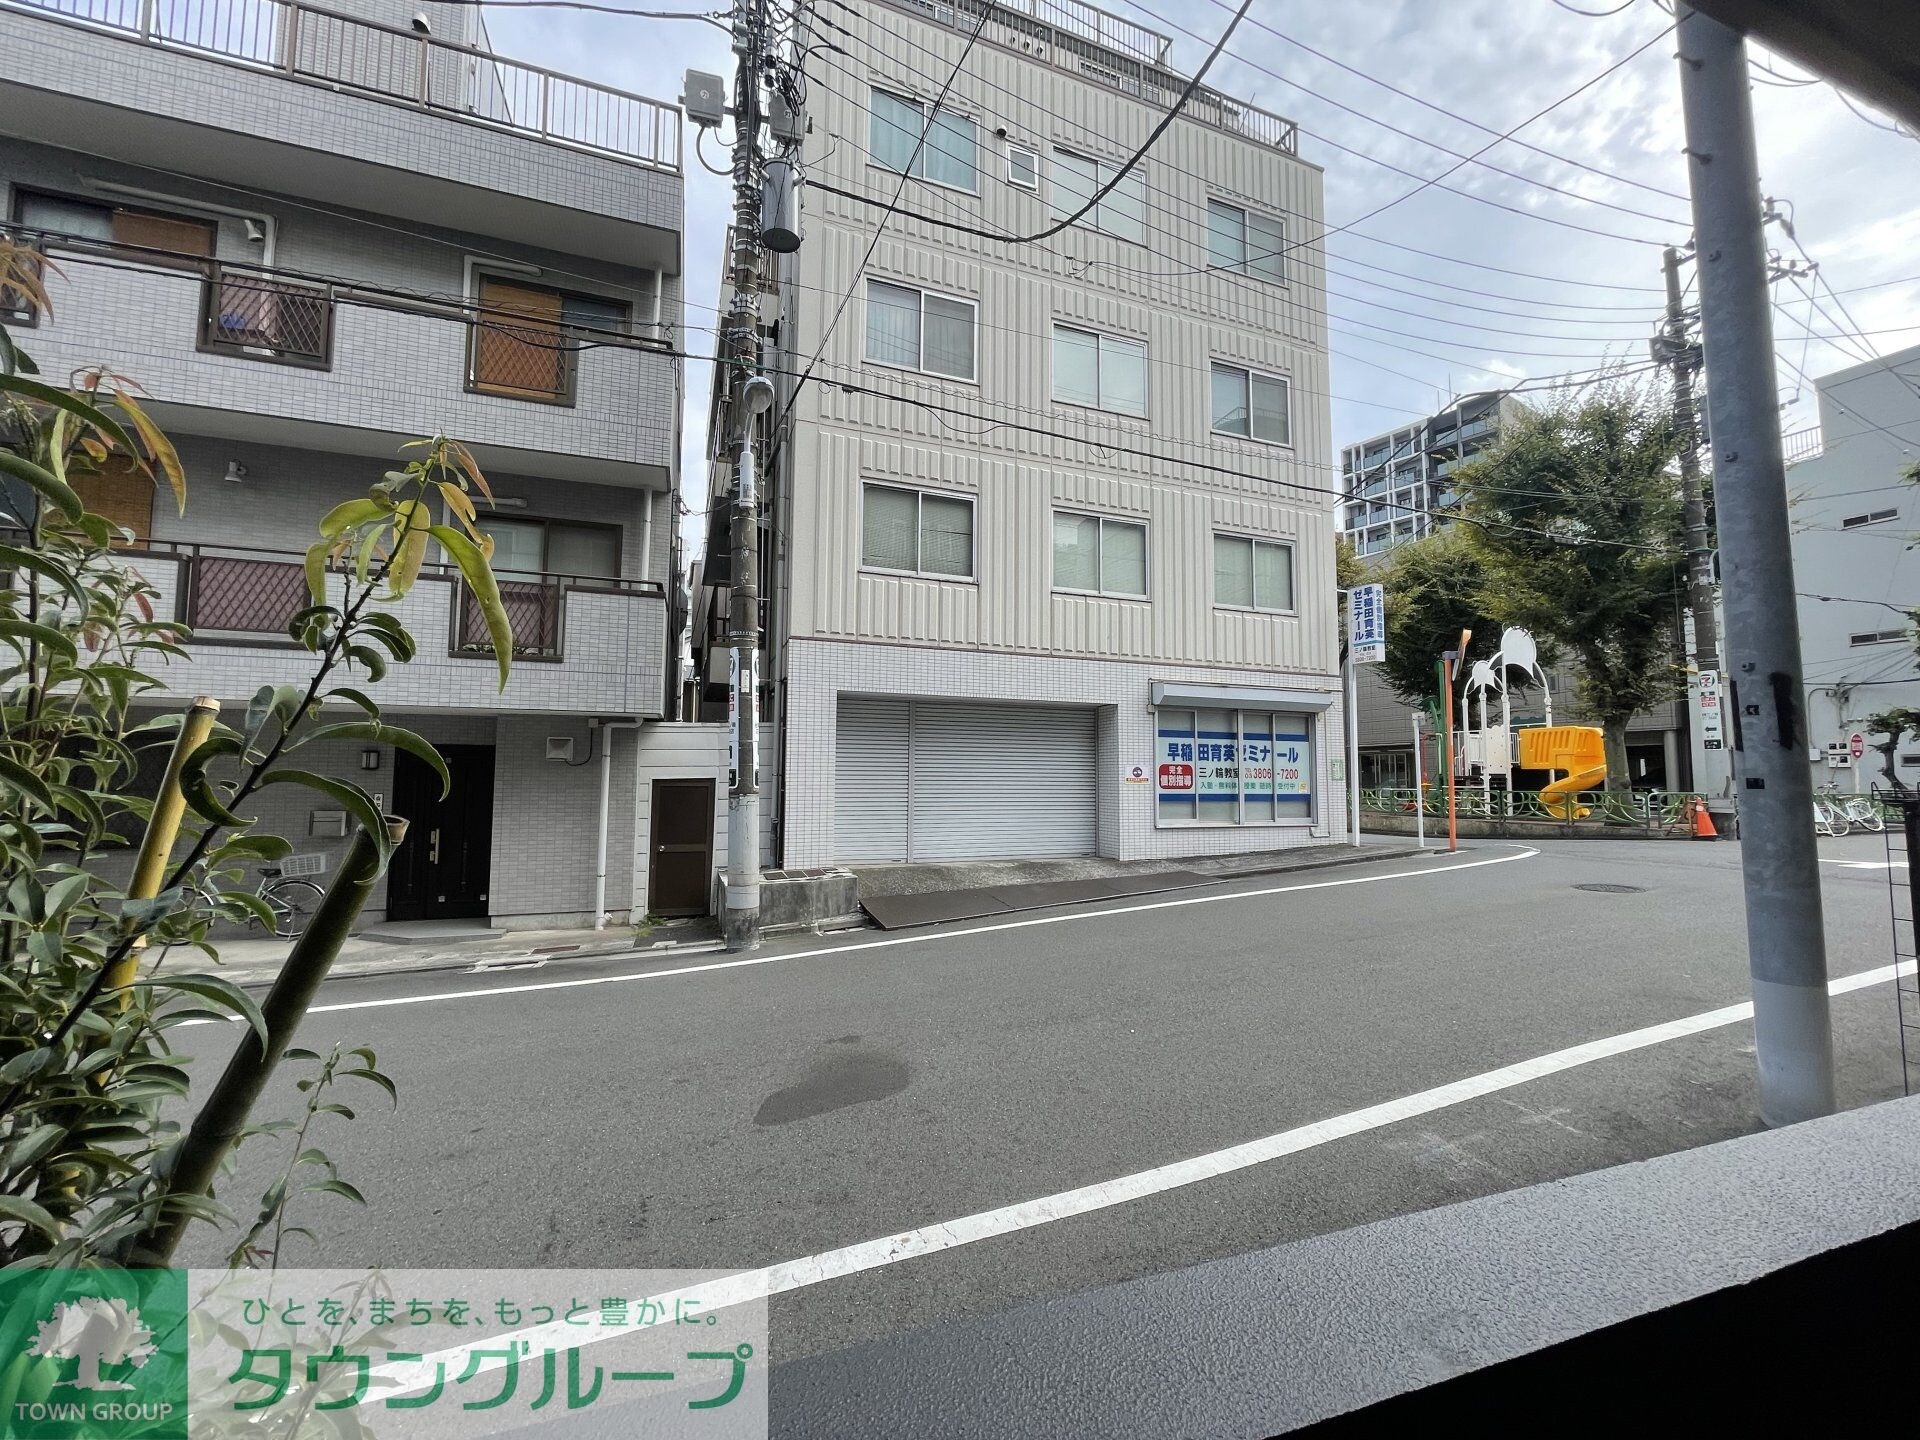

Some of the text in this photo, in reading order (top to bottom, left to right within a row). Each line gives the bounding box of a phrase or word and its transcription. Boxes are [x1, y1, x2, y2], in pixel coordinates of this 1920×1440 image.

[1353, 590, 1364, 641] ゼミナール
[1364, 587, 1375, 640] 早稲田育英
[1168, 765, 1183, 775] 完全
[1199, 767, 1239, 779] 三ノ輪教室
[1253, 767, 1299, 780] 3806-7200
[1160, 775, 1192, 787] 個別指導
